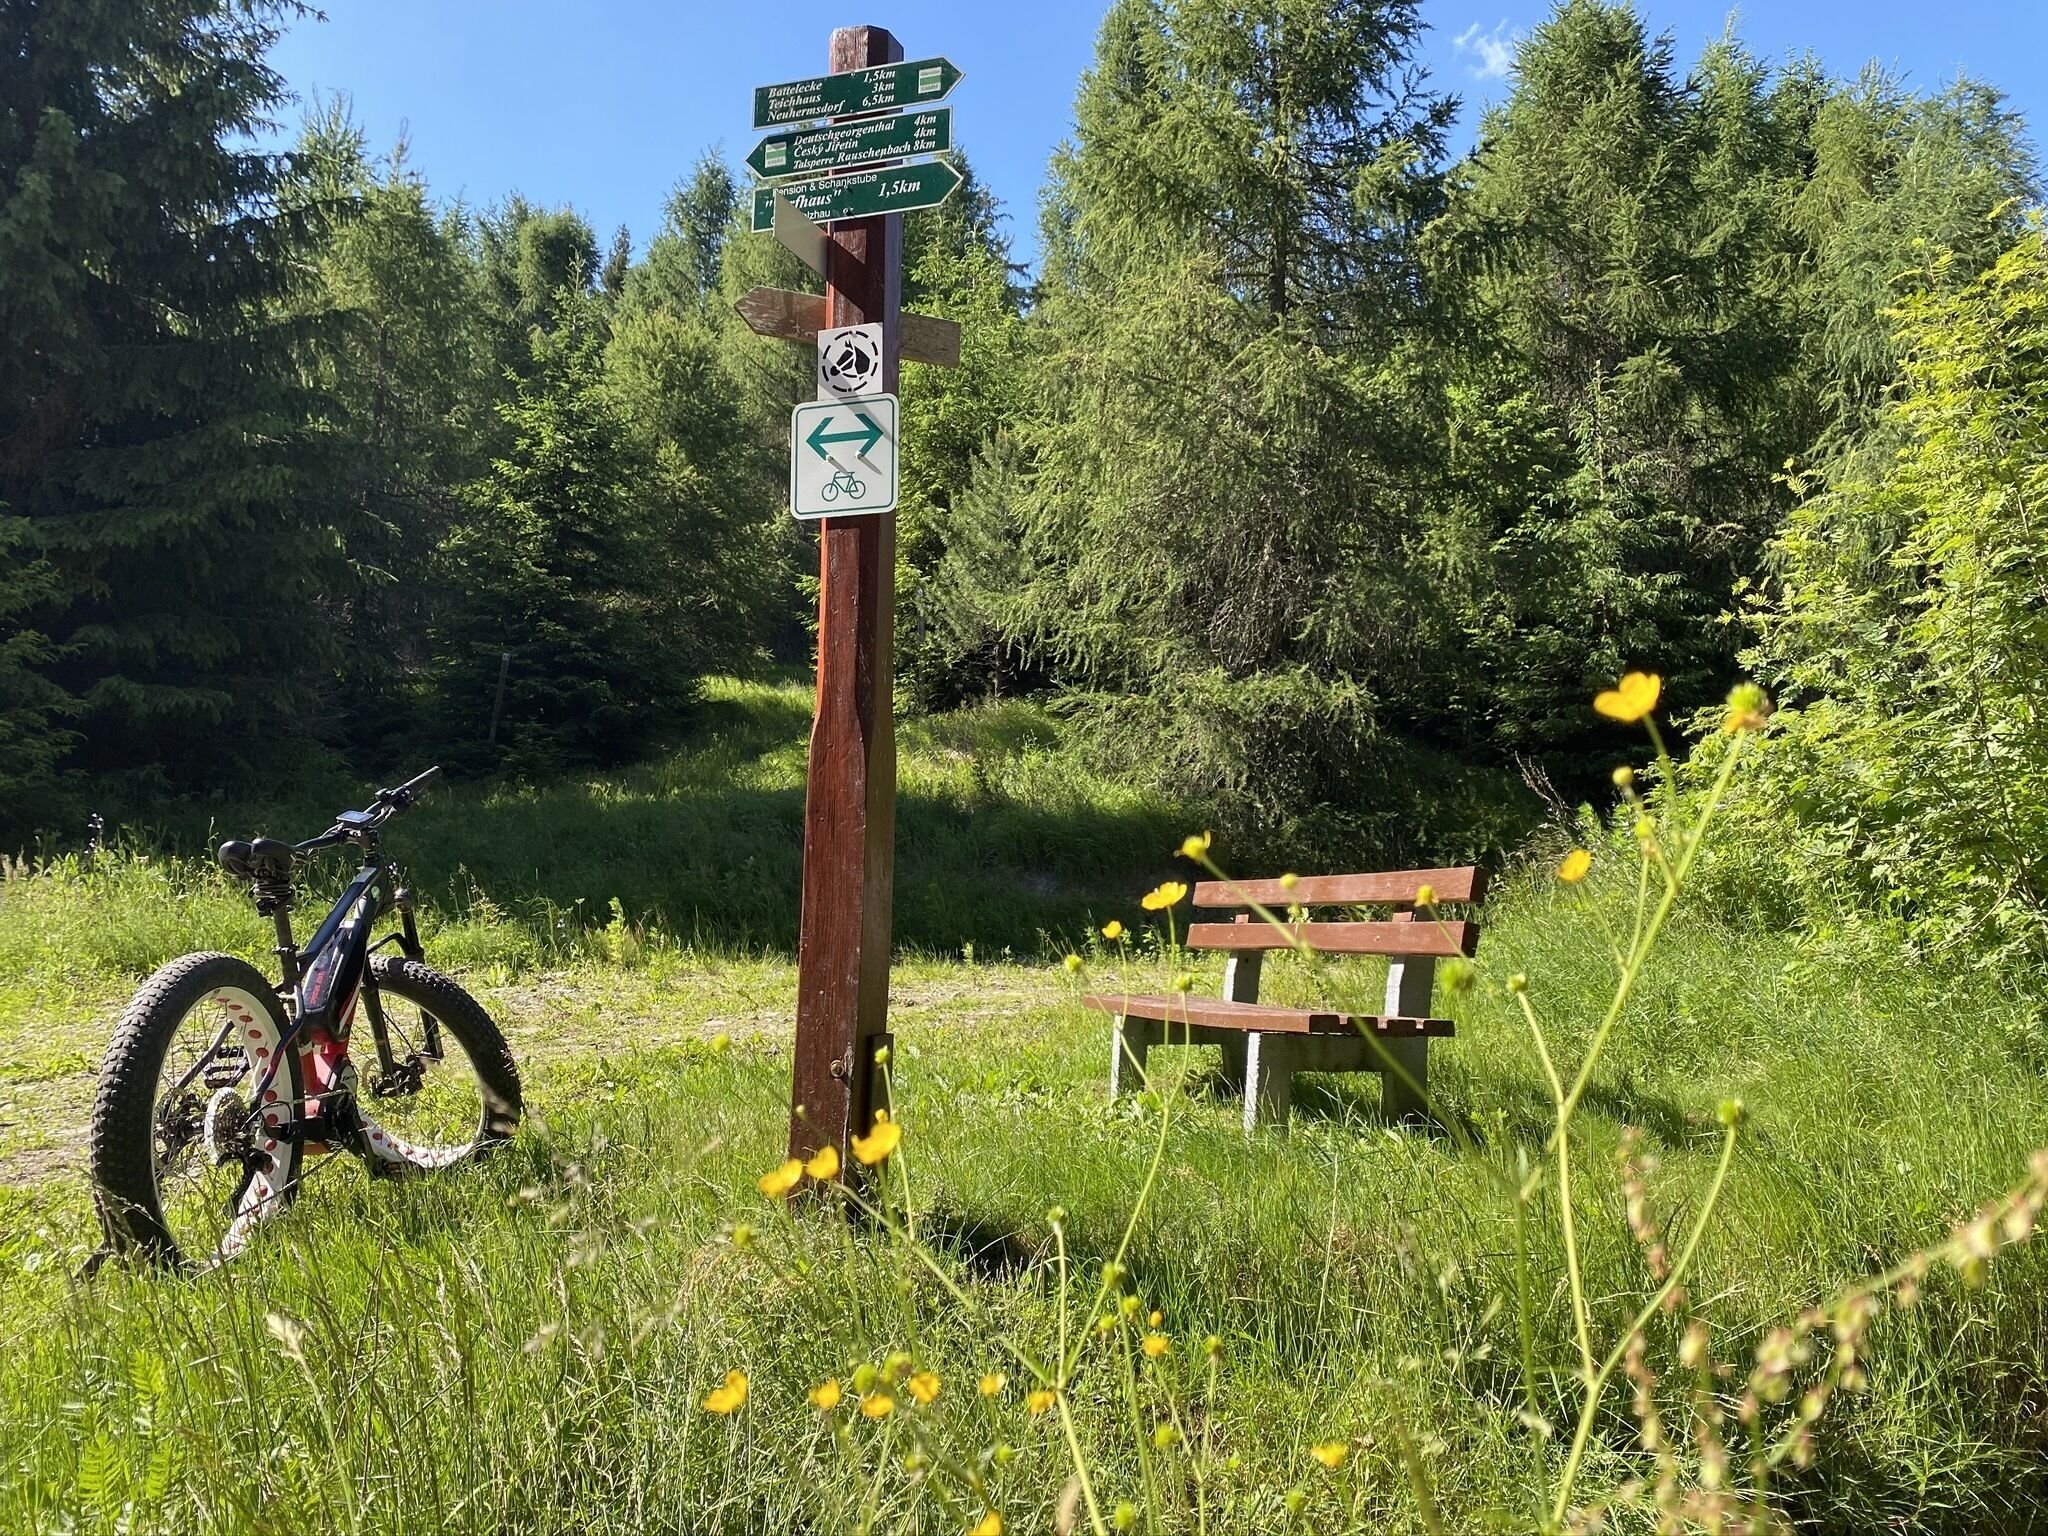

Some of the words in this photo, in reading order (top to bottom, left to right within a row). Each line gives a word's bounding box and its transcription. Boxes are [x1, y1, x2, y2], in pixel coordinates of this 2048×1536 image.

[767, 81, 823, 99] Battelecke
[863, 69, 896, 84] 1,5km
[767, 94, 821, 110] Teichhaus
[871, 82, 895, 94] 3km
[766, 100, 846, 122] Neuhermsdorf
[862, 94, 895, 108] 6,5km
[793, 119, 896, 146] Deutschgeorgenthal
[913, 115, 937, 126] 4km
[793, 143, 824, 158] Český
[913, 127, 937, 139] 4km
[792, 157, 835, 170] Talsperre
[836, 141, 911, 162] Rauschenbach
[913, 140, 936, 151] 8km
[809, 181, 817, 192] &
[818, 174, 878, 190] Schankstube
[877, 179, 921, 198] 1,5km
